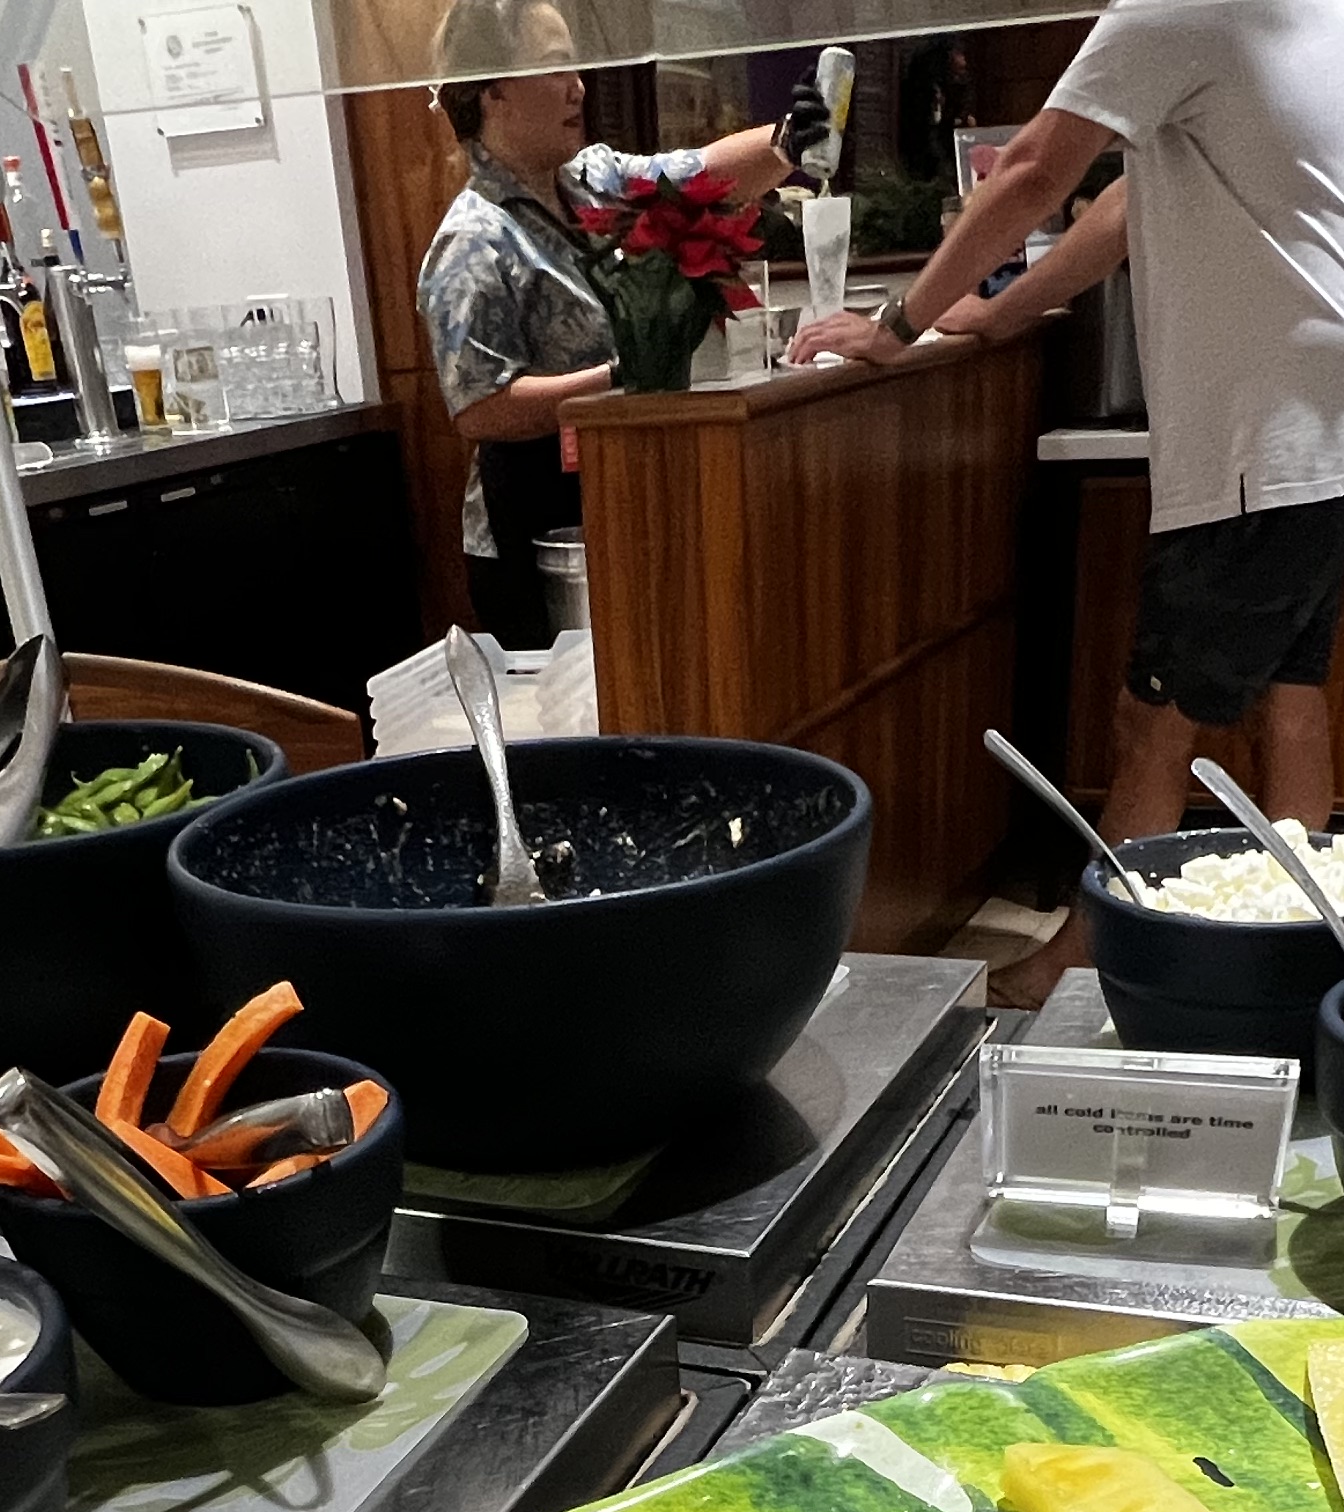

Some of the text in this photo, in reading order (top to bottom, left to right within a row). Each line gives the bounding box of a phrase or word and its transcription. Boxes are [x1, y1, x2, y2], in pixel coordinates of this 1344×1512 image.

[1035, 1105, 1058, 1116] all
[1064, 1107, 1103, 1118] cold
[1170, 1114, 1203, 1126] are
[1208, 1115, 1254, 1129] time
